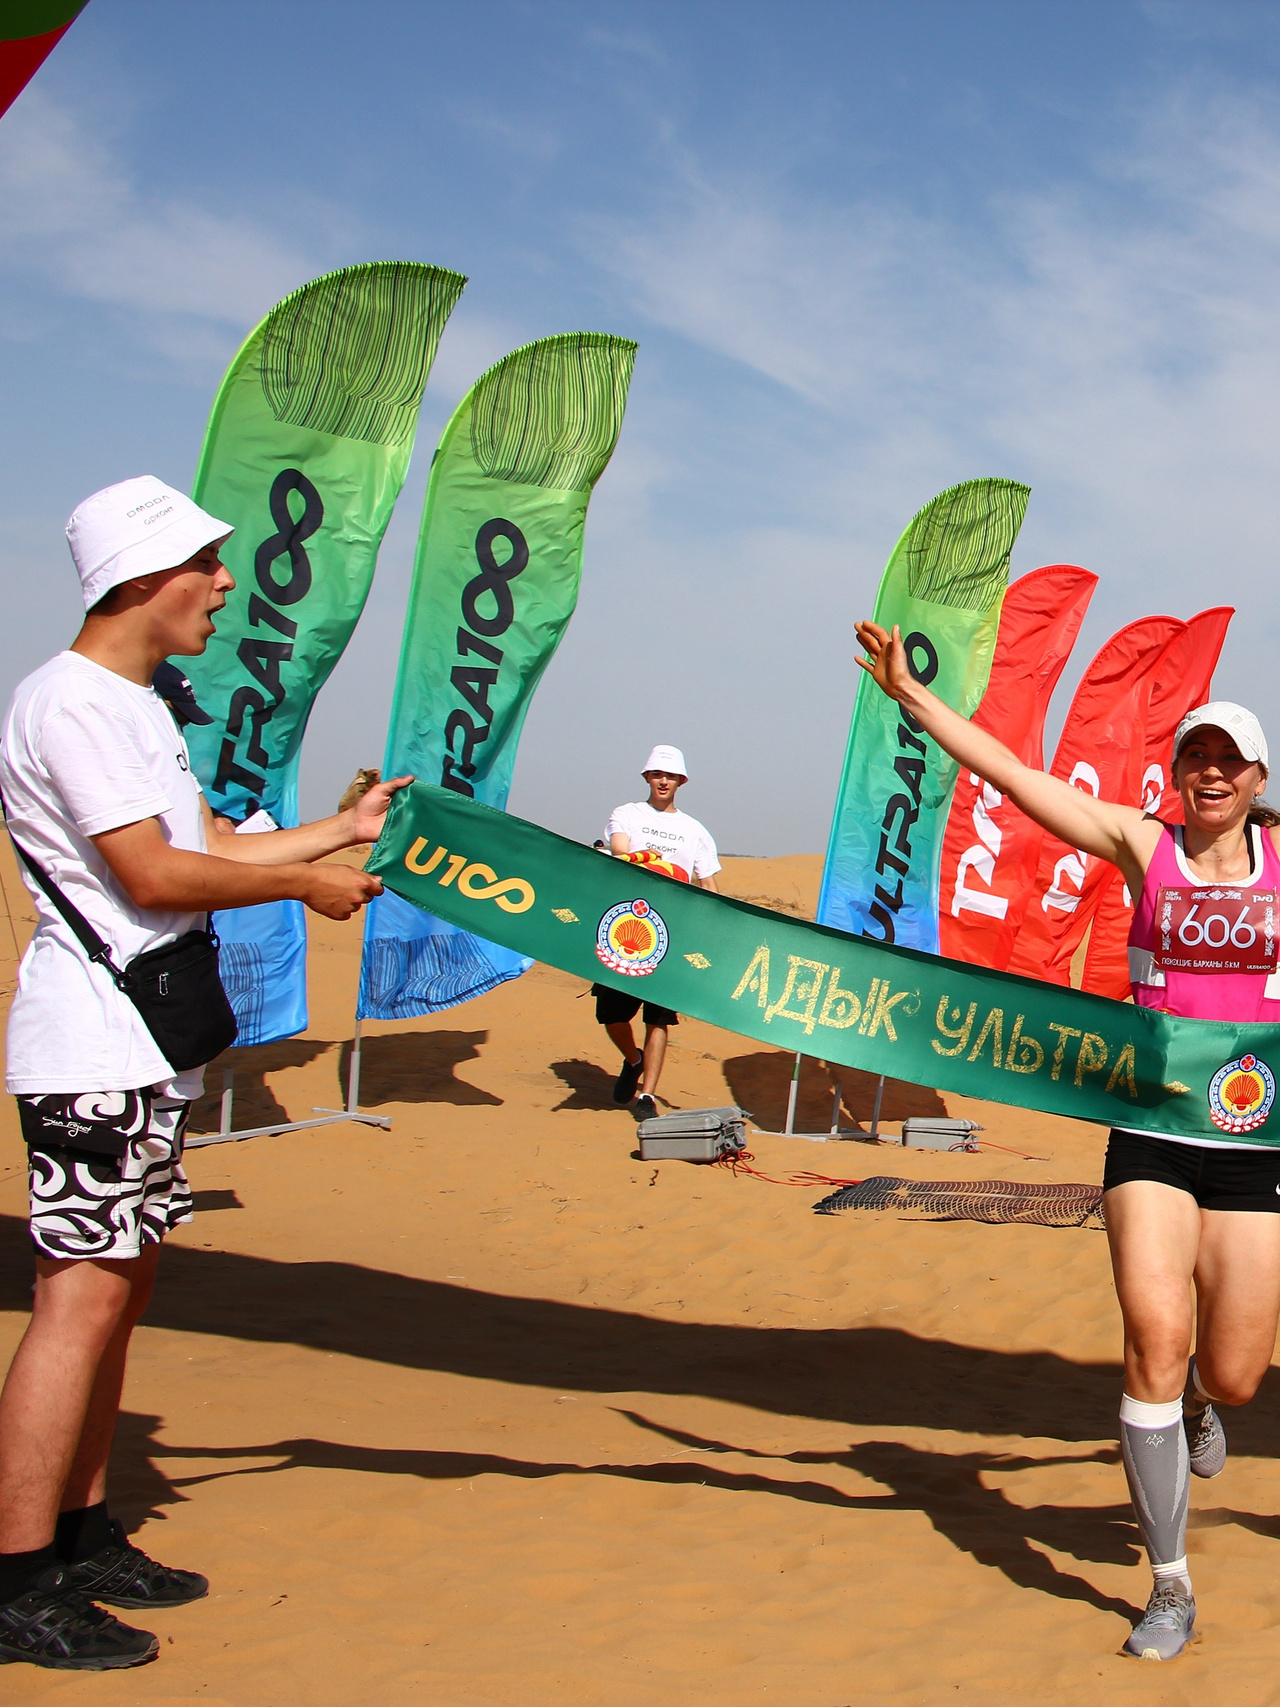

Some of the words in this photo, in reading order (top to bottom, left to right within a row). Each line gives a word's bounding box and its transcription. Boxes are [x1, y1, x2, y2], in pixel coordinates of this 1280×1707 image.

[1178, 904, 1257, 949] 606
[1161, 957, 1192, 967] ПОЮЩИЕ
[1193, 959, 1222, 969] БАРХАНЫ
[731, 942, 914, 1043] АДЫК
[930, 994, 1138, 1098] УЛЬТРА
